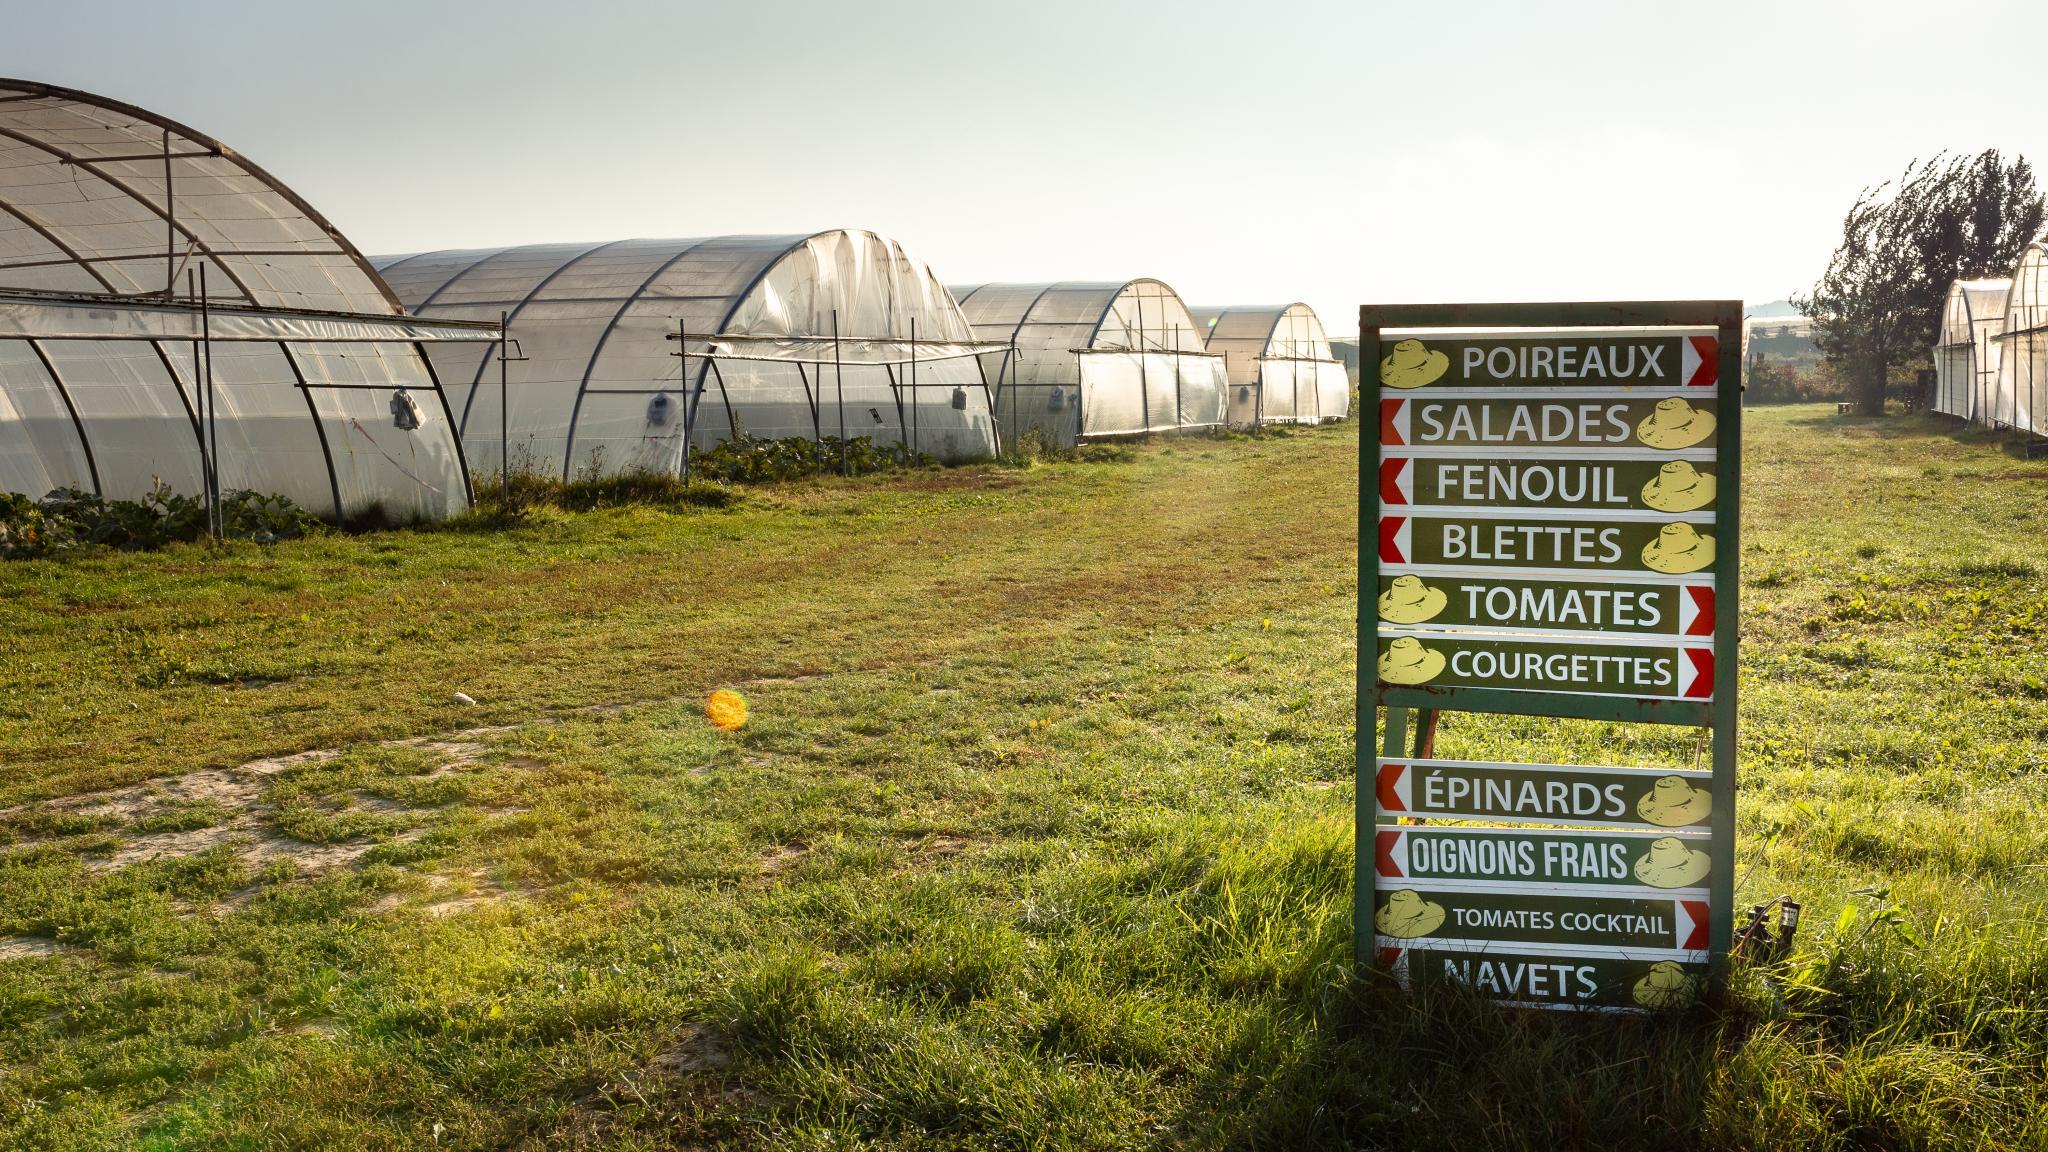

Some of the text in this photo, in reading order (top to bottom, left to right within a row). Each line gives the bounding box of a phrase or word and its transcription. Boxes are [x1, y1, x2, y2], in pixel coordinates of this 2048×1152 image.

[1463, 344, 1664, 379] POIREAUX
[1420, 404, 1630, 442] SALADES
[1438, 464, 1628, 502] FENOUIL
[1442, 525, 1621, 563] BLETTES
[1461, 585, 1660, 627] TOMATES
[1451, 650, 1672, 686] COURGETTES
[1424, 769, 1626, 817] ÉPINARDS
[1412, 837, 1627, 879] OIGNONS FRAIS
[1453, 908, 1669, 936] TOMATES COCKTAIL
[1443, 958, 1597, 999] NAVETS
